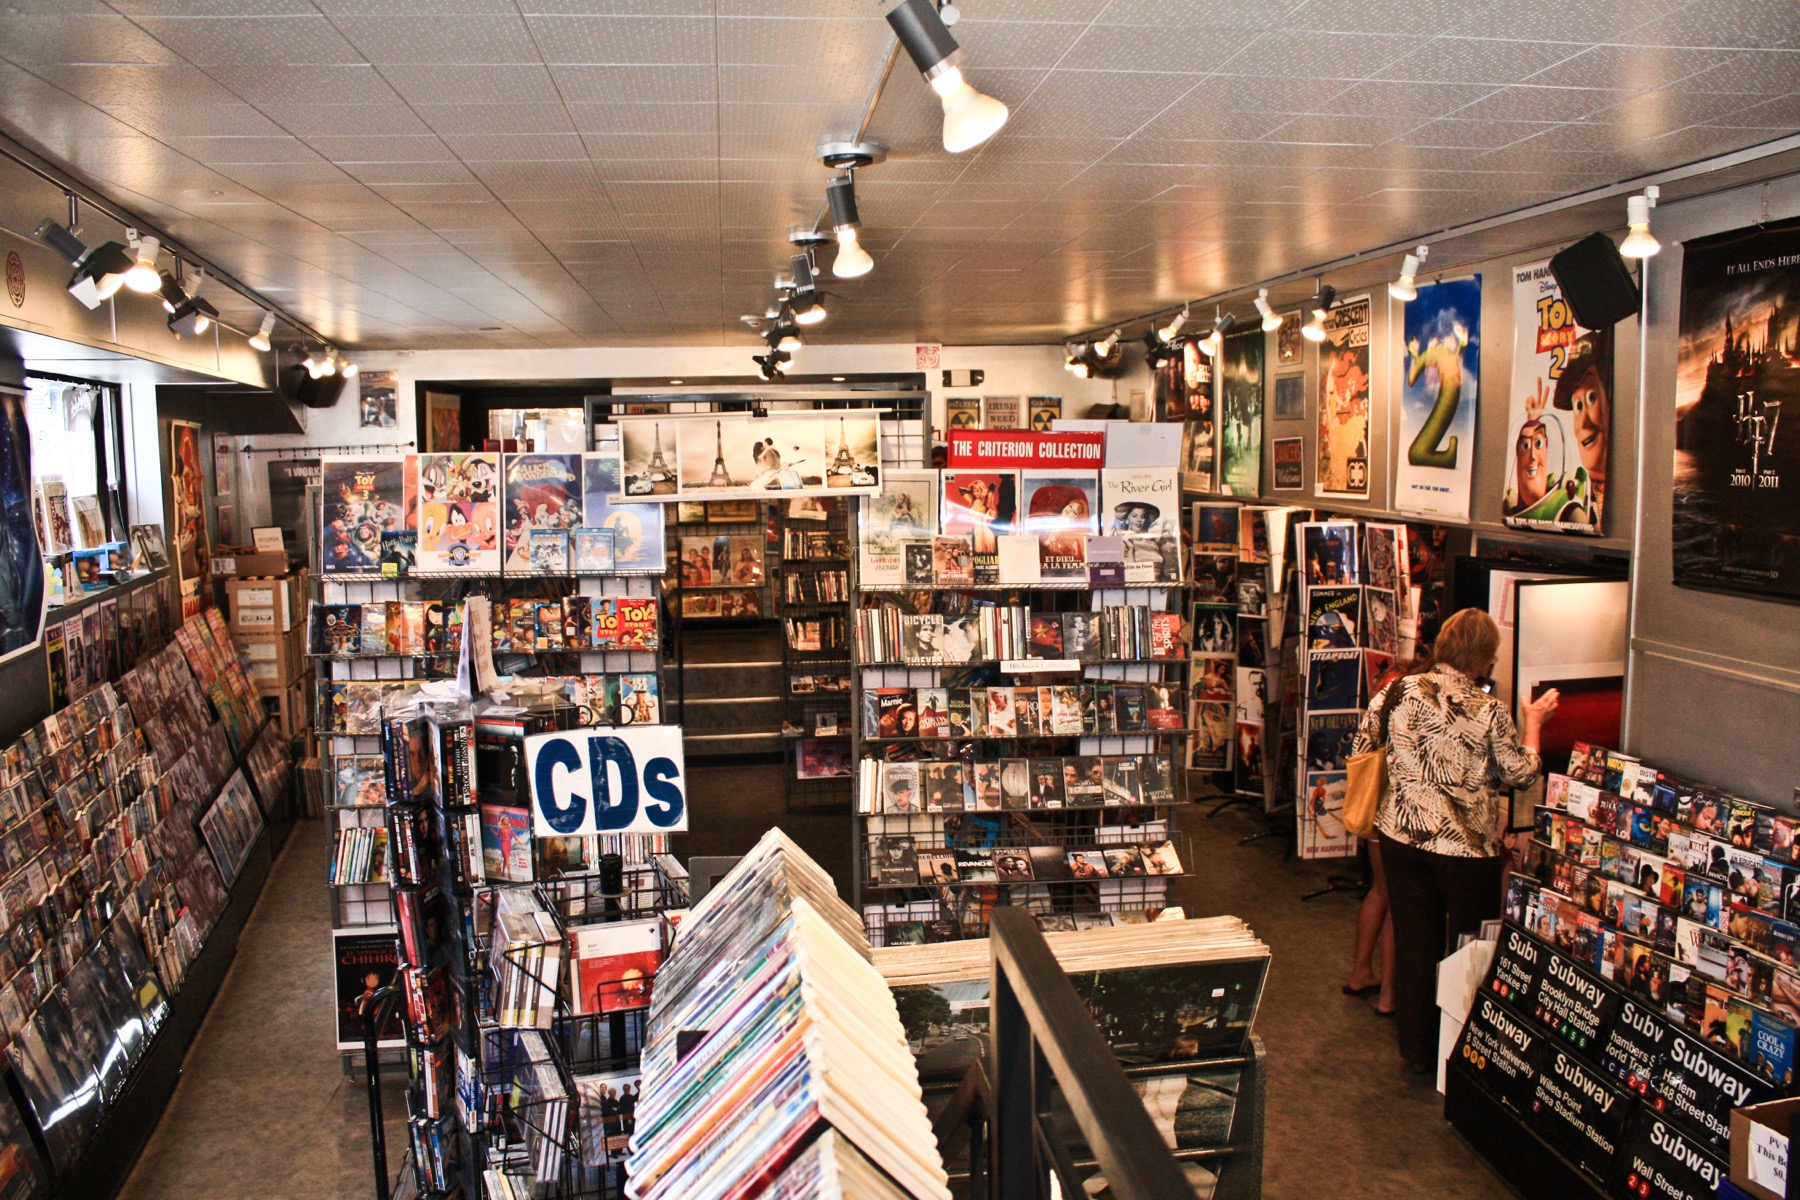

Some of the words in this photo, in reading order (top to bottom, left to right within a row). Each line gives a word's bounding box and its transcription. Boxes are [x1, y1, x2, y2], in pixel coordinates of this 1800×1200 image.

[1727, 265, 1735, 276] IT
[1737, 263, 1750, 273] ALL
[1753, 258, 1776, 271] ENDS
[1778, 254, 1800, 267] HERE
[1516, 270, 1532, 283] TOM
[1540, 281, 1557, 293] Disney
[1335, 302, 1369, 329] CRESCENT
[1549, 347, 1567, 380] 2
[988, 401, 1017, 411] IRISH
[990, 414, 1016, 423] NEED
[953, 440, 973, 456] THE
[978, 441, 1033, 458] CRITERION
[1038, 441, 1101, 460] COLLECTION
[515, 469, 576, 482] WONDERLAND
[519, 462, 550, 473] ALICE
[354, 475, 375, 486] TOY
[1120, 480, 1151, 493] River
[1152, 479, 1174, 492] Girl
[1730, 473, 1751, 486] 2010
[1758, 475, 1779, 488] 2011
[362, 490, 369, 500] 3
[1554, 520, 1594, 533] THANKSGIVING
[621, 606, 651, 621] TOY
[903, 615, 941, 624] BICYCLE
[1309, 608, 1323, 626] NEW
[1324, 593, 1358, 611] ENGLAND
[595, 613, 617, 628] TO
[633, 629, 643, 642] 2
[1162, 617, 1173, 650] SPIRITS
[880, 696, 903, 708] Marnie
[534, 735, 685, 834] CDs
[1731, 808, 1752, 817] AFRICAN
[1553, 880, 1571, 893] LIFE
[1508, 932, 1538, 964] Sub
[1500, 956, 1511, 970] 161
[1496, 967, 1520, 993] Yankee
[1548, 955, 1605, 1009] Subway
[1541, 978, 1574, 1008] Brooklyn
[1574, 1001, 1600, 1027] Bridge
[1538, 991, 1553, 1010] City
[1553, 1004, 1568, 1021] Hall
[1568, 1012, 1597, 1039] Station
[1481, 1000, 1533, 1051] Subway
[1610, 1030, 1649, 1063] hambers
[1757, 1030, 1778, 1046] COOL
[1466, 1032, 1471, 1042] 8
[1472, 1034, 1492, 1056] Street
[1491, 1052, 1517, 1078] Station
[1470, 1020, 1483, 1038] New
[1484, 1030, 1499, 1050] York
[1499, 1043, 1535, 1079] University
[1756, 1039, 1786, 1059] CRAZY
[1671, 1037, 1752, 1107] Subway
[1555, 1053, 1615, 1113] Subway
[1663, 1069, 1697, 1100] Harlem
[1539, 1073, 1562, 1100] Willets
[1562, 1090, 1583, 1114] Point
[1659, 1083, 1674, 1101] 148
[1674, 1094, 1706, 1124] Street
[1535, 1086, 1554, 1107] Shea
[1554, 1098, 1585, 1132] Stadium
[1585, 1125, 1614, 1155] Station
[1650, 1121, 1727, 1190] Subway
[1756, 1143, 1775, 1160] This
[1632, 1156, 1653, 1180] Wall
[1653, 1172, 1684, 1200] Street
